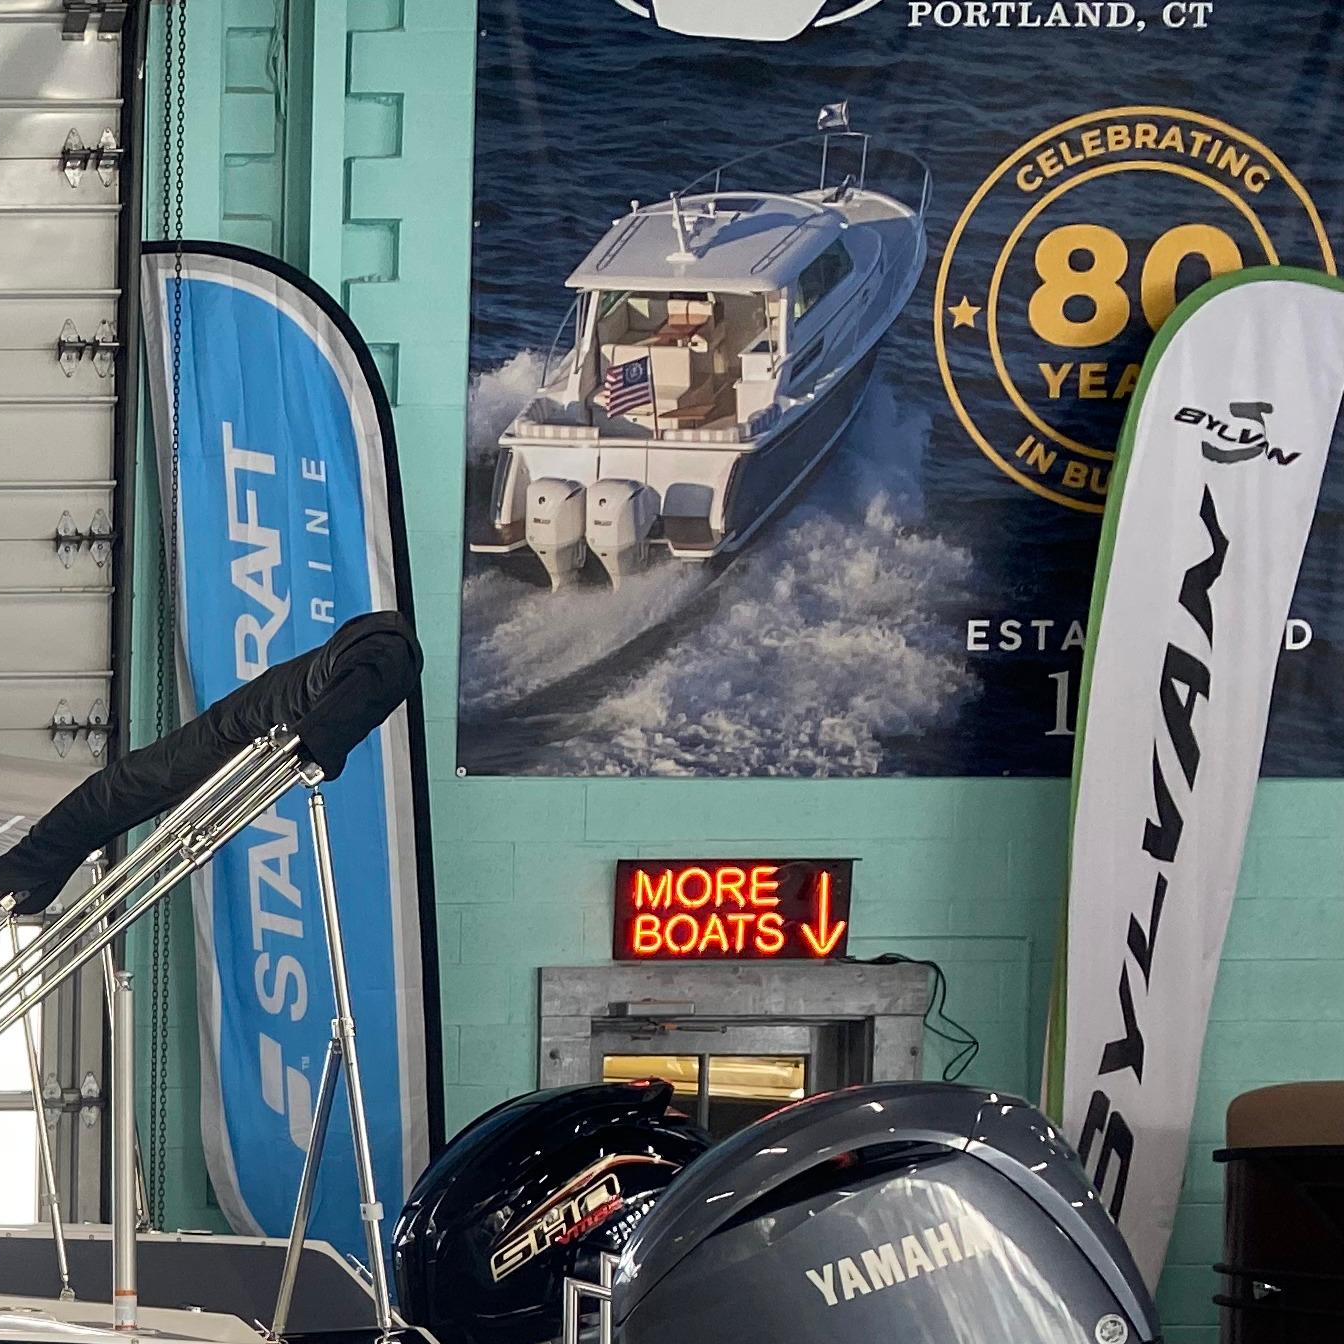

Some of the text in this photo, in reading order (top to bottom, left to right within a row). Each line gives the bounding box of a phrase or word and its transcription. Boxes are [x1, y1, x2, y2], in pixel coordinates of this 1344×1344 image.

[908, 1, 1213, 32] PORTLAND, CT
[1016, 122, 1271, 193] CELEBRATING
[1028, 222, 1244, 348] 80
[1015, 434, 1057, 475] IN
[632, 866, 781, 910] MORE
[632, 911, 786, 955] BOATS
[804, 1221, 995, 1307] YAMAHA
